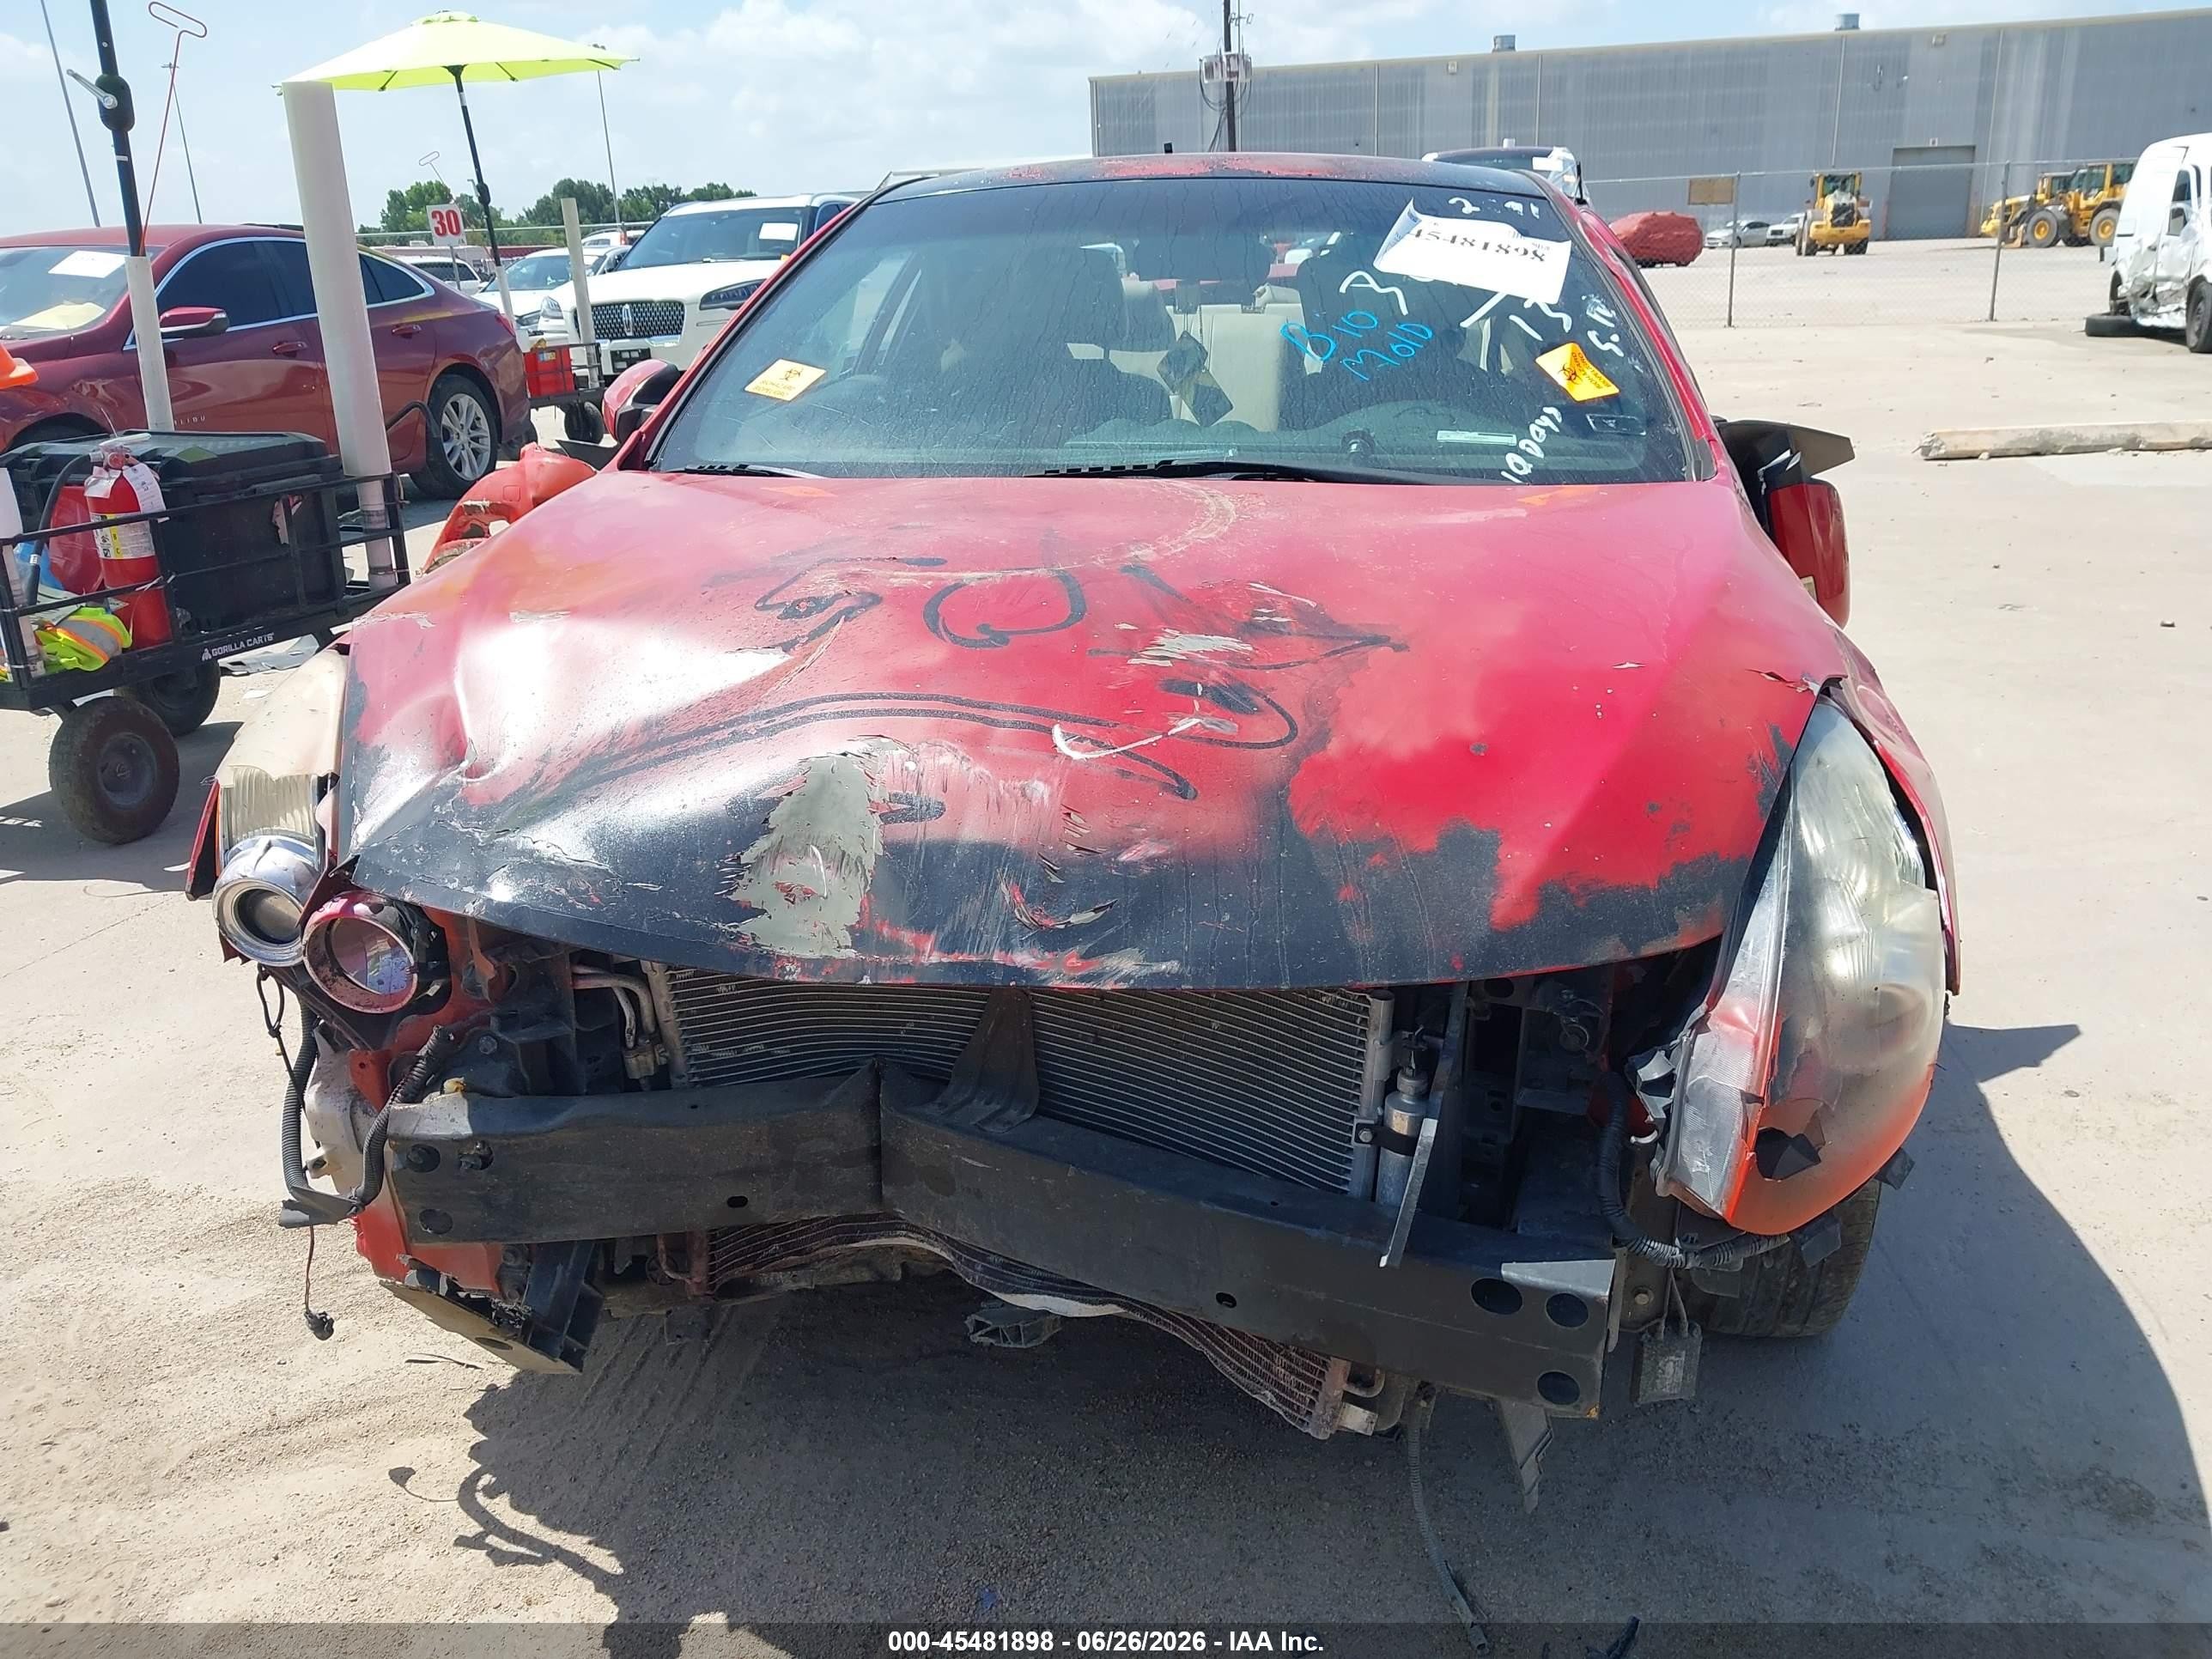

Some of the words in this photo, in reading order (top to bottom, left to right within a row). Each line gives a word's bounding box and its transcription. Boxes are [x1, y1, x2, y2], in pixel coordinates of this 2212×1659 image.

[431, 210, 461, 236] 30
[211, 641, 246, 657] GORILLA
[246, 634, 274, 647] CARTS
